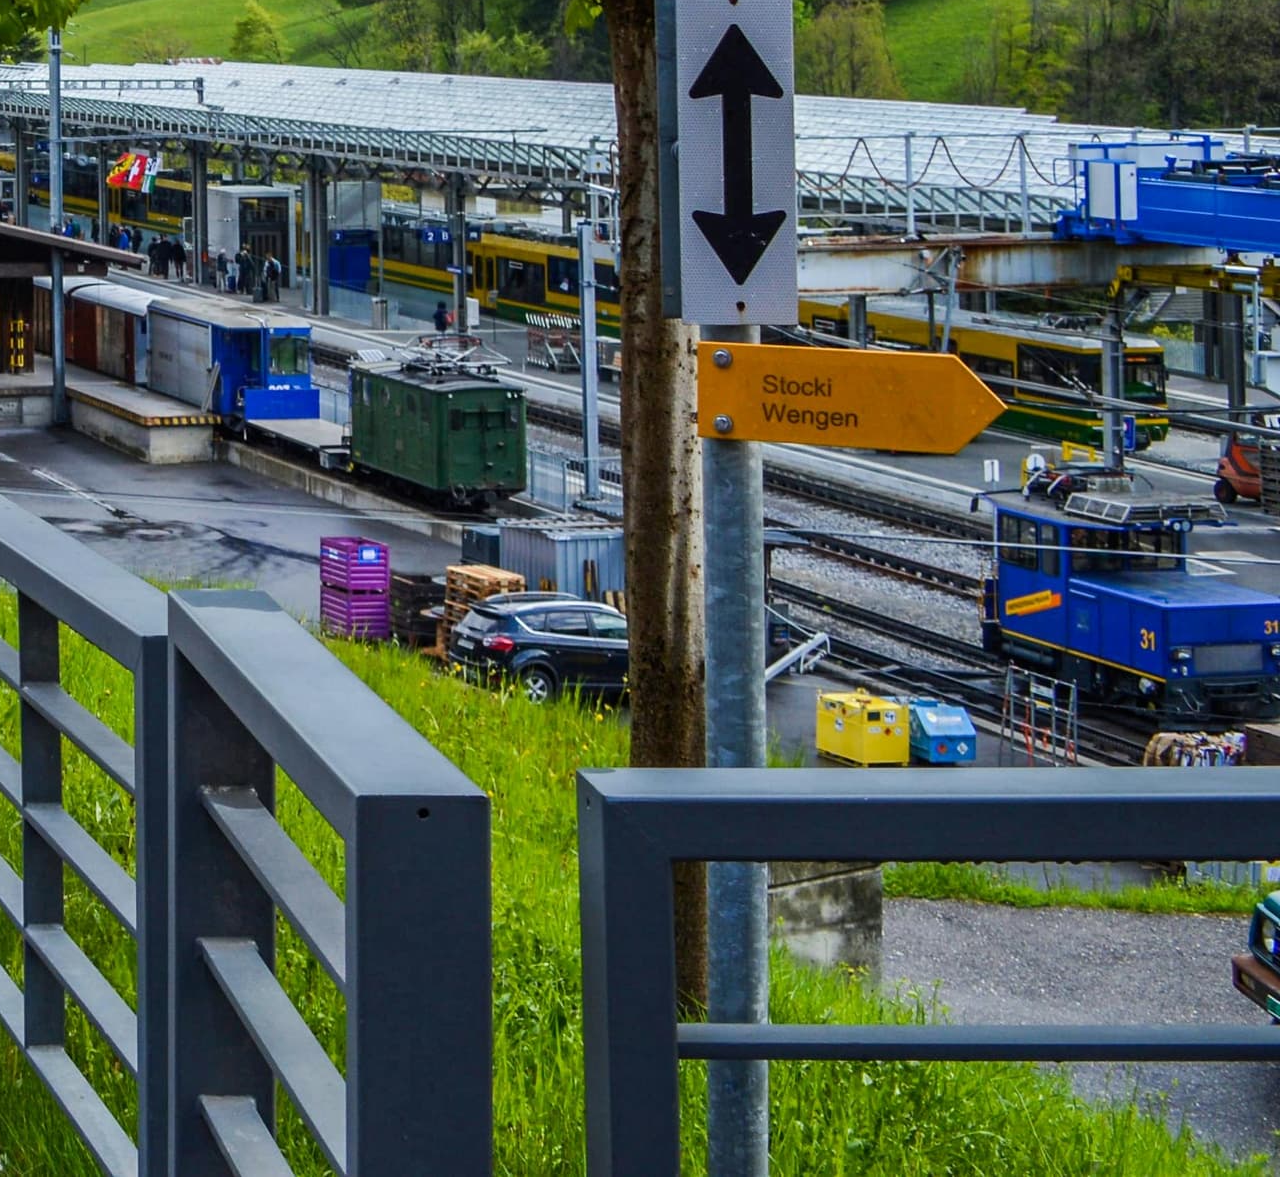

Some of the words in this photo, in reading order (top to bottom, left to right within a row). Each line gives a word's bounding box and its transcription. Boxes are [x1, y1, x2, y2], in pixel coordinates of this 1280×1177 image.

[427, 231, 434, 242] 2
[442, 231, 449, 242] B
[762, 374, 832, 398] Stocki
[761, 402, 859, 431] Wengen
[1263, 620, 1279, 635] 31
[1140, 628, 1156, 652] 31
